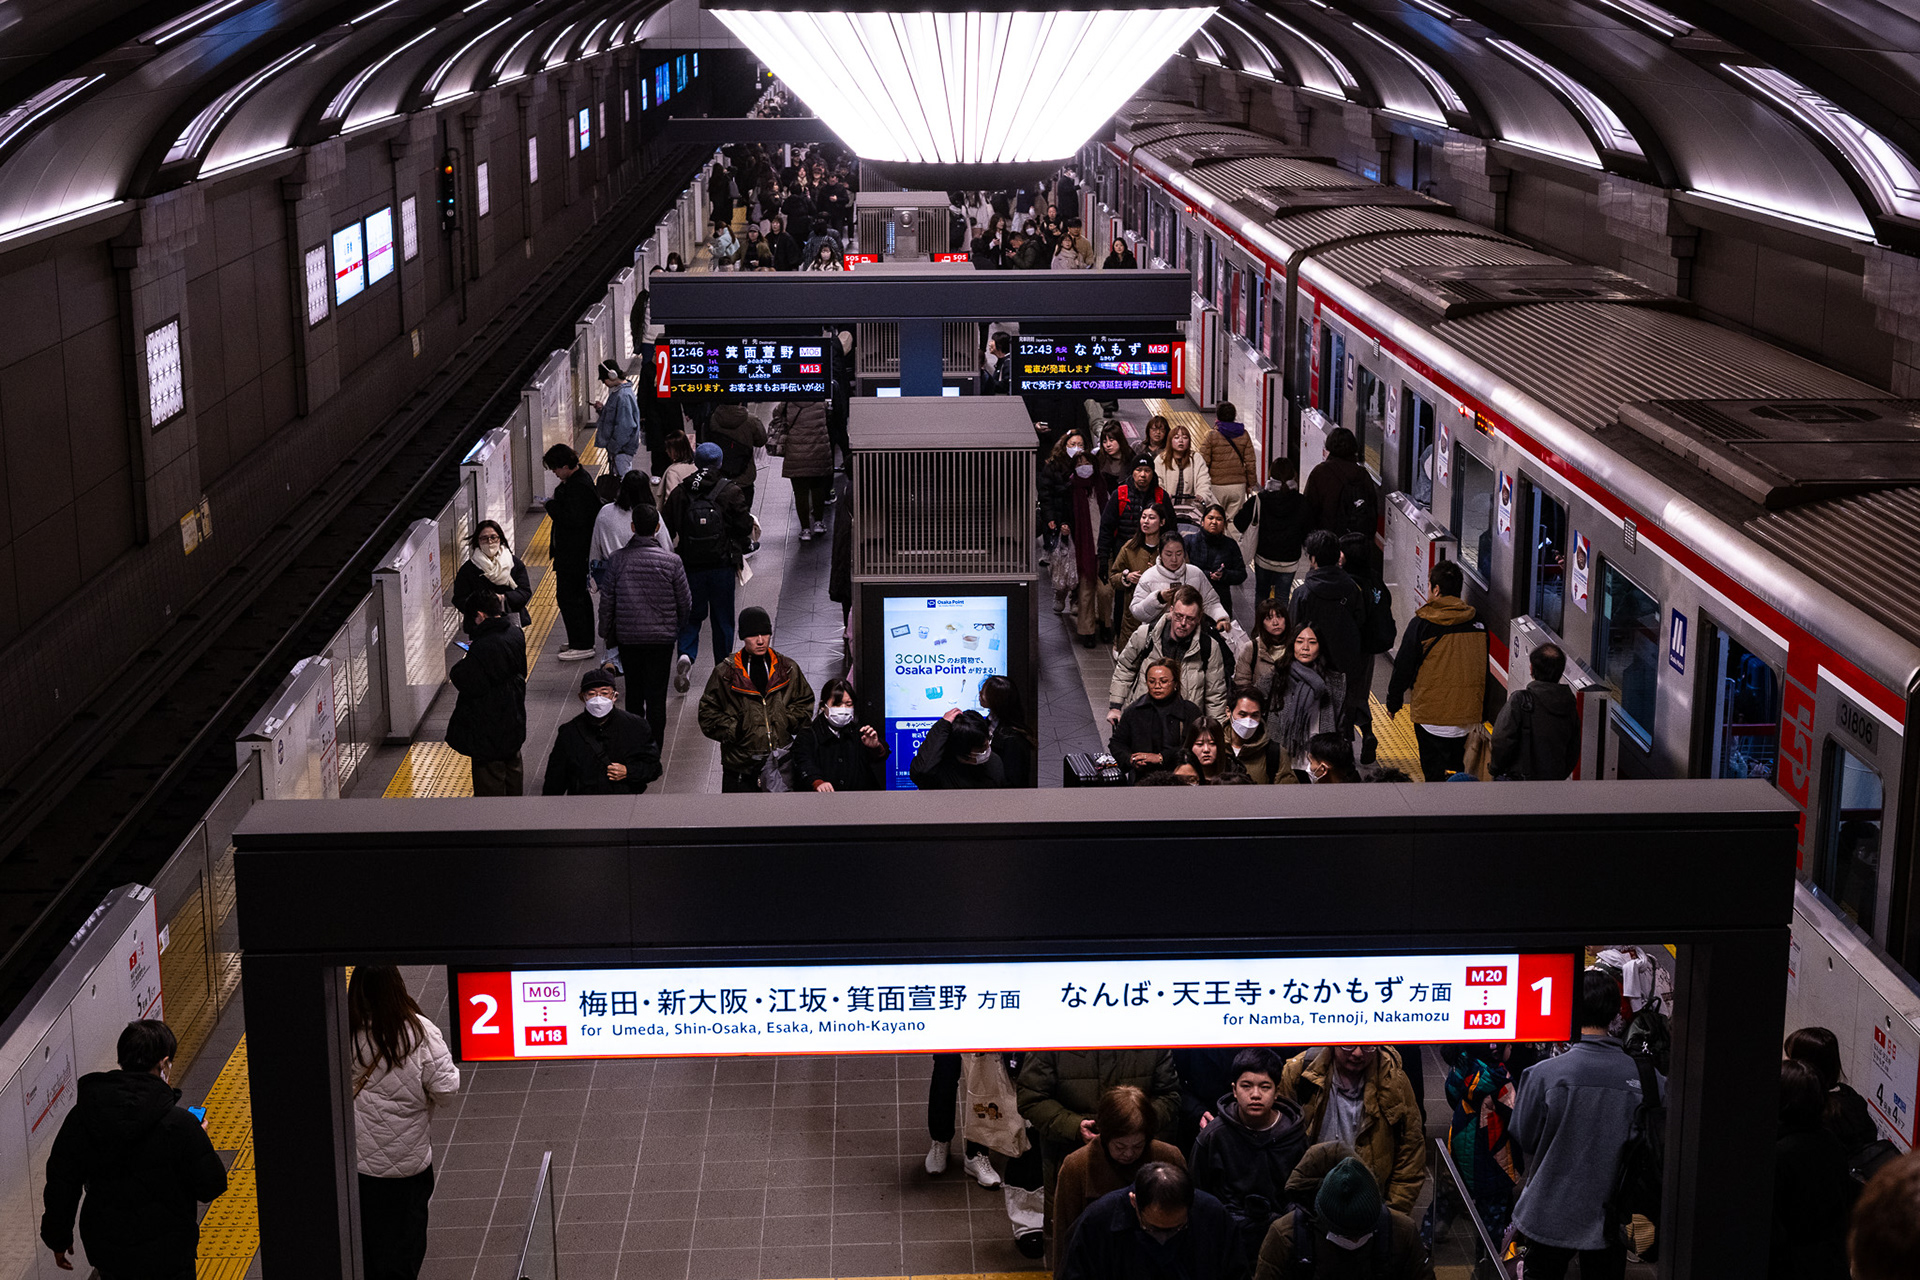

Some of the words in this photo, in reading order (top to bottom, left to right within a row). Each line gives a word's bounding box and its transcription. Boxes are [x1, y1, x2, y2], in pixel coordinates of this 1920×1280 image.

[672, 347, 704, 357] 12:46
[800, 348, 820, 356] M06
[1020, 345, 1052, 354] 12:43
[1074, 343, 1142, 356] なかもず
[658, 351, 668, 392] 2
[672, 364, 704, 374] 12:50
[738, 365, 782, 374] 新大阪
[800, 365, 820, 373] M13
[1024, 364, 1092, 373] 電車が発車します
[1174, 348, 1181, 388] 1
[671, 383, 724, 392] っております。
[729, 383, 824, 392] お客さまもお手伝いが必
[895, 654, 946, 664] 3COINS
[895, 665, 932, 675] Osaka
[935, 665, 966, 674] Point
[1840, 704, 1873, 744] 31806
[1471, 970, 1502, 982] M20
[529, 987, 561, 998] M06
[1061, 976, 1404, 1008] なんば・天王寺・なかもず
[1409, 982, 1452, 1002] 方面
[1531, 977, 1552, 1016] 1
[579, 985, 967, 1017] 梅田・新大阪・江坂・箕面萱野
[977, 990, 1020, 1010] 方面
[469, 994, 500, 1034] 2
[1224, 1013, 1244, 1025] for
[1249, 1012, 1304, 1025] Namba,
[1309, 1011, 1368, 1025] Tennoji,
[1374, 1010, 1450, 1023] Nakamozu
[1469, 1014, 1501, 1026] M30
[581, 1024, 602, 1036] for
[612, 1023, 669, 1037] Umeda,
[674, 1022, 762, 1036] Shin-Osaka,
[767, 1021, 813, 1035] Esaka,
[818, 1020, 925, 1034] Minoh-Kayano
[531, 1030, 562, 1042] M18
